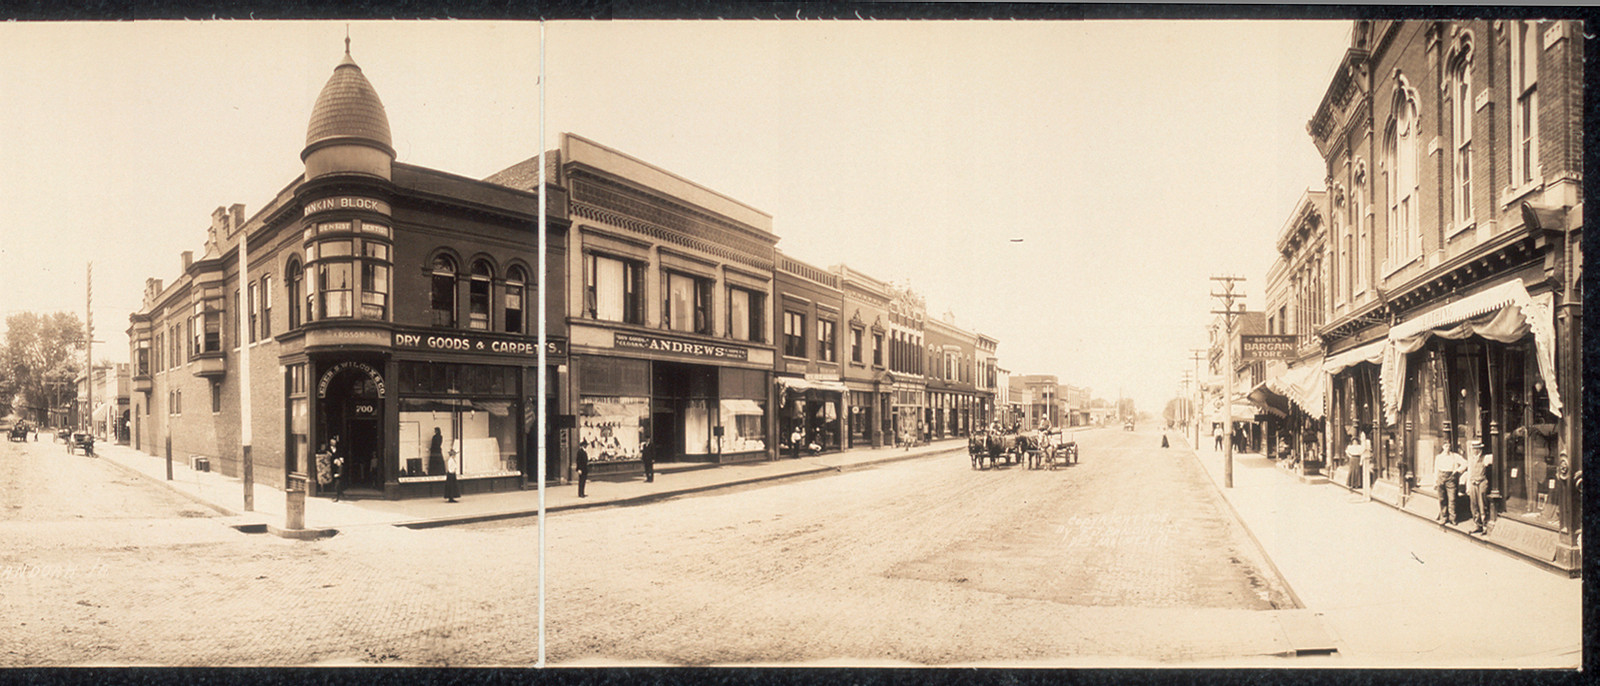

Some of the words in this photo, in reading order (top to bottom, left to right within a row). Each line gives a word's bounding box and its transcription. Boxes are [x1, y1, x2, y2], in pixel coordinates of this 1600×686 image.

[341, 198, 378, 210] BLOCK
[319, 222, 350, 232] DENTIST
[396, 334, 421, 347] DRY
[427, 336, 470, 350] GOODS
[476, 341, 484, 350] &
[1244, 343, 1293, 351] BARGAIN
[649, 340, 725, 356] ANDREWS
[355, 404, 374, 413] 700
